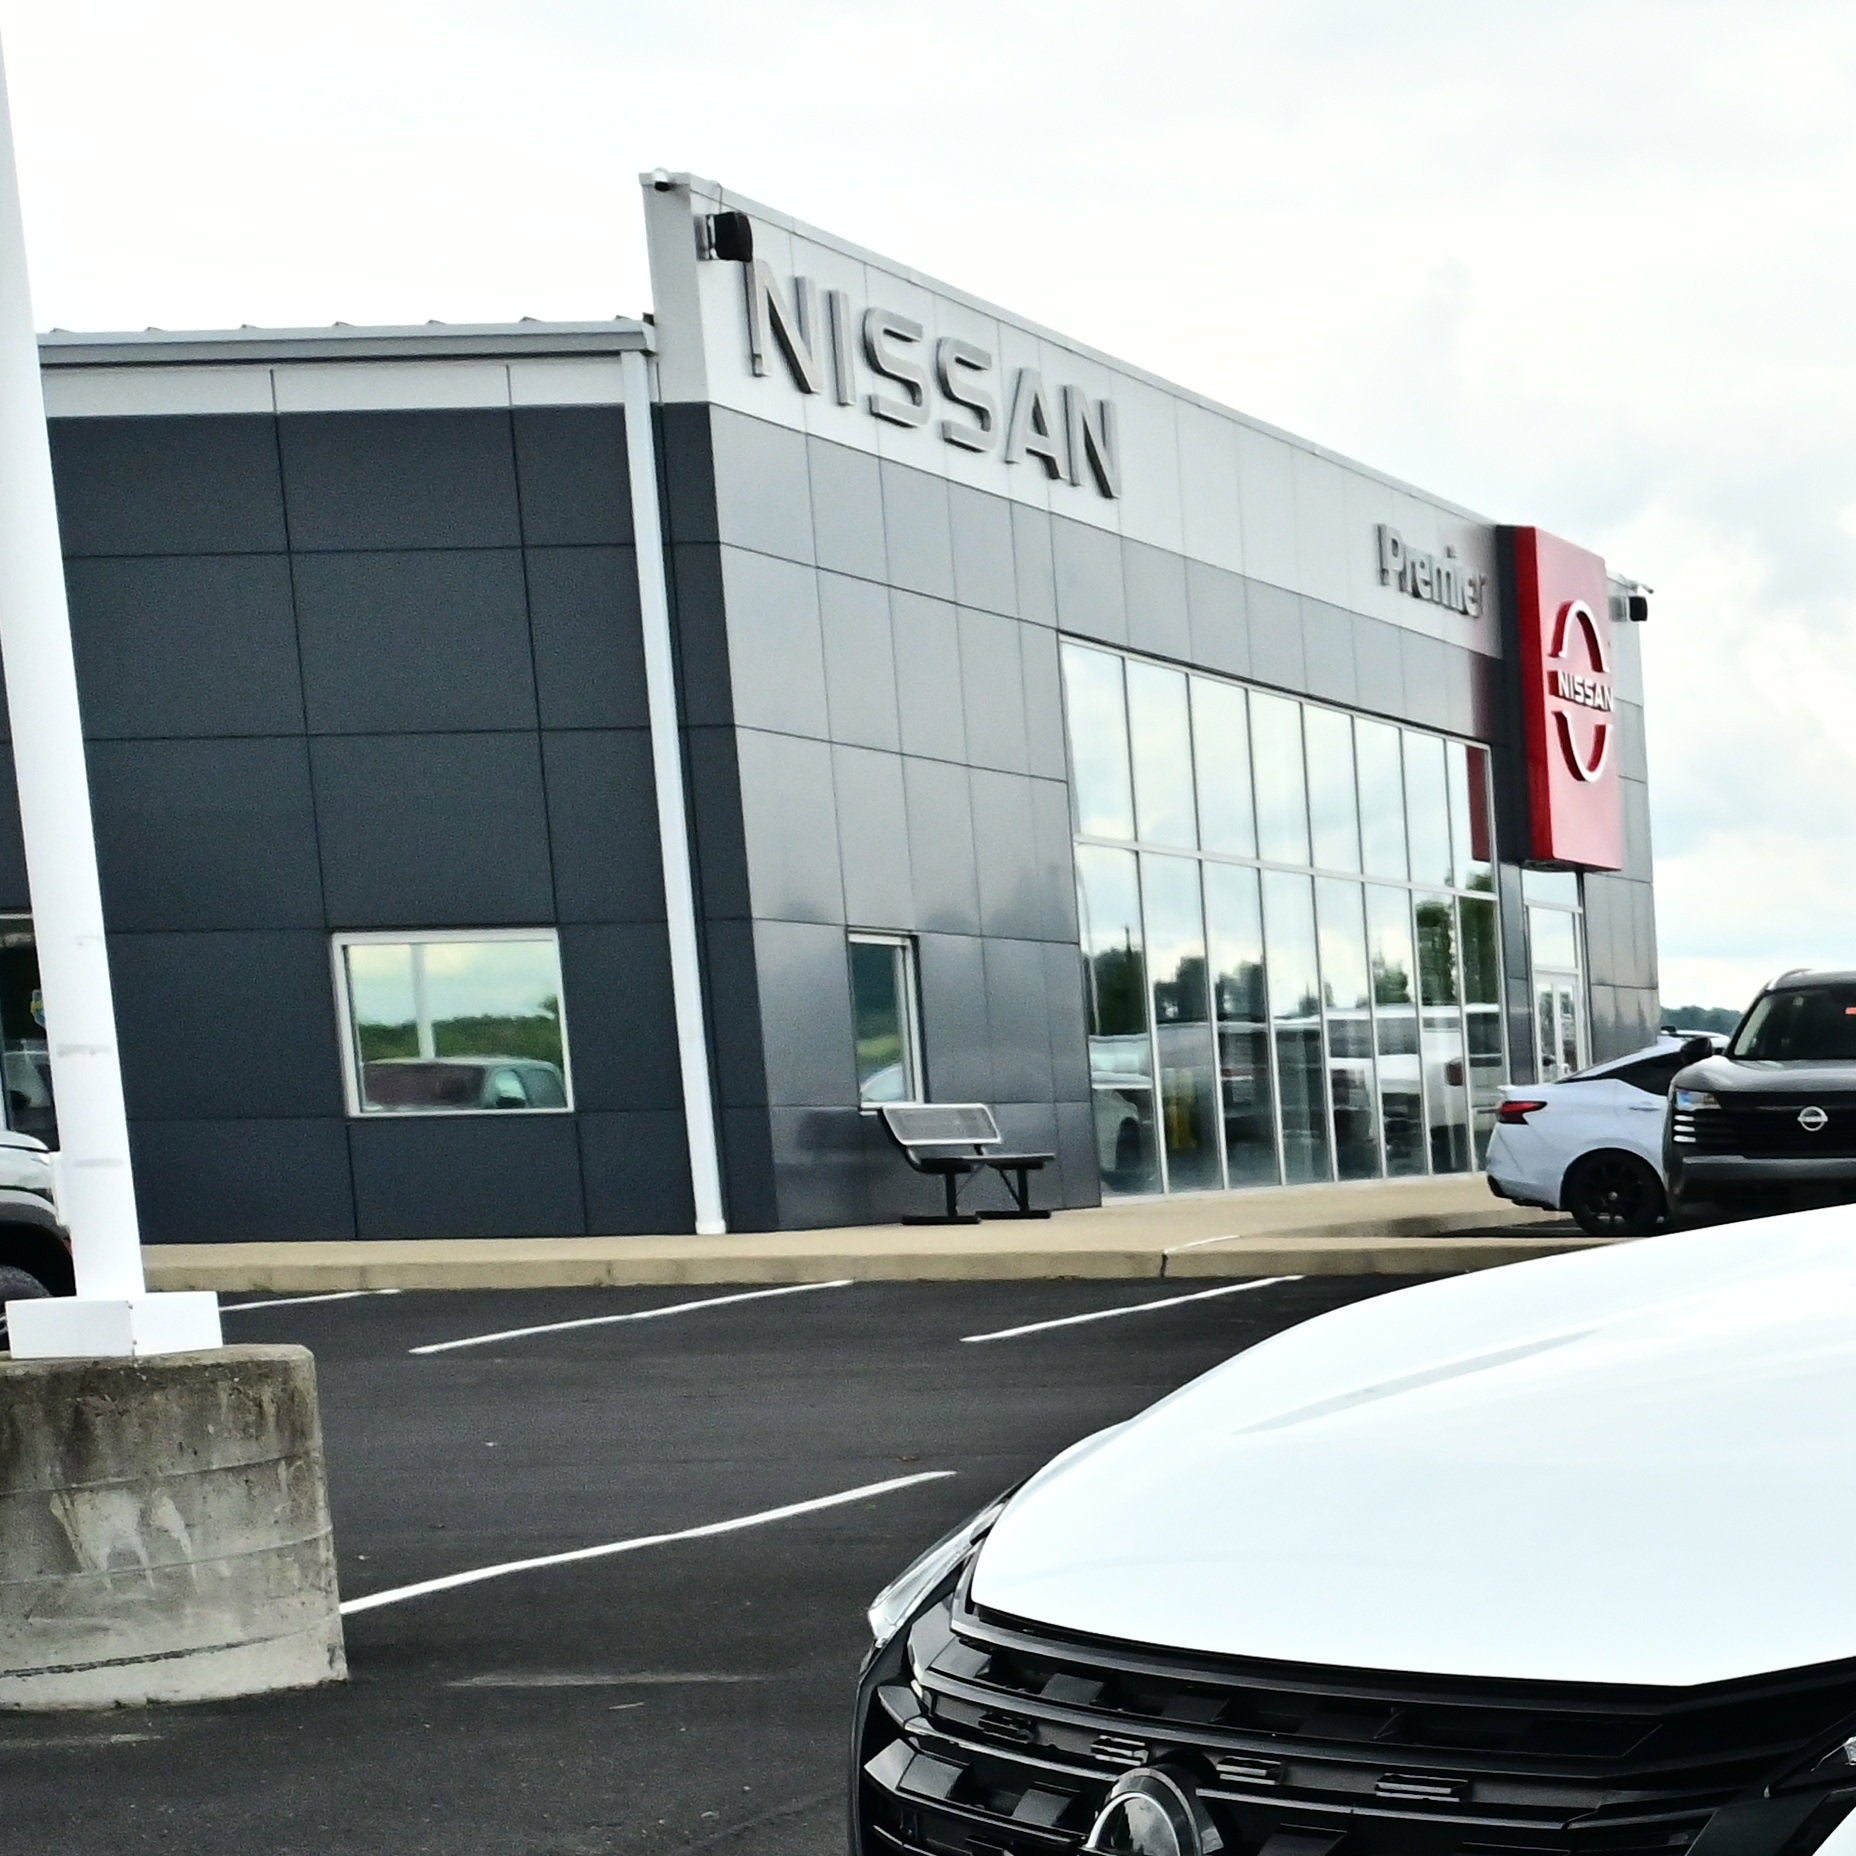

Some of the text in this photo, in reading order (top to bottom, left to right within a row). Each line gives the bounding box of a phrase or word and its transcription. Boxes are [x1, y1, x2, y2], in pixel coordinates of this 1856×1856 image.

[744, 258, 1122, 499] NISSAN
[1376, 523, 1487, 619] Premier
[1558, 669, 1614, 712] NISSAN
